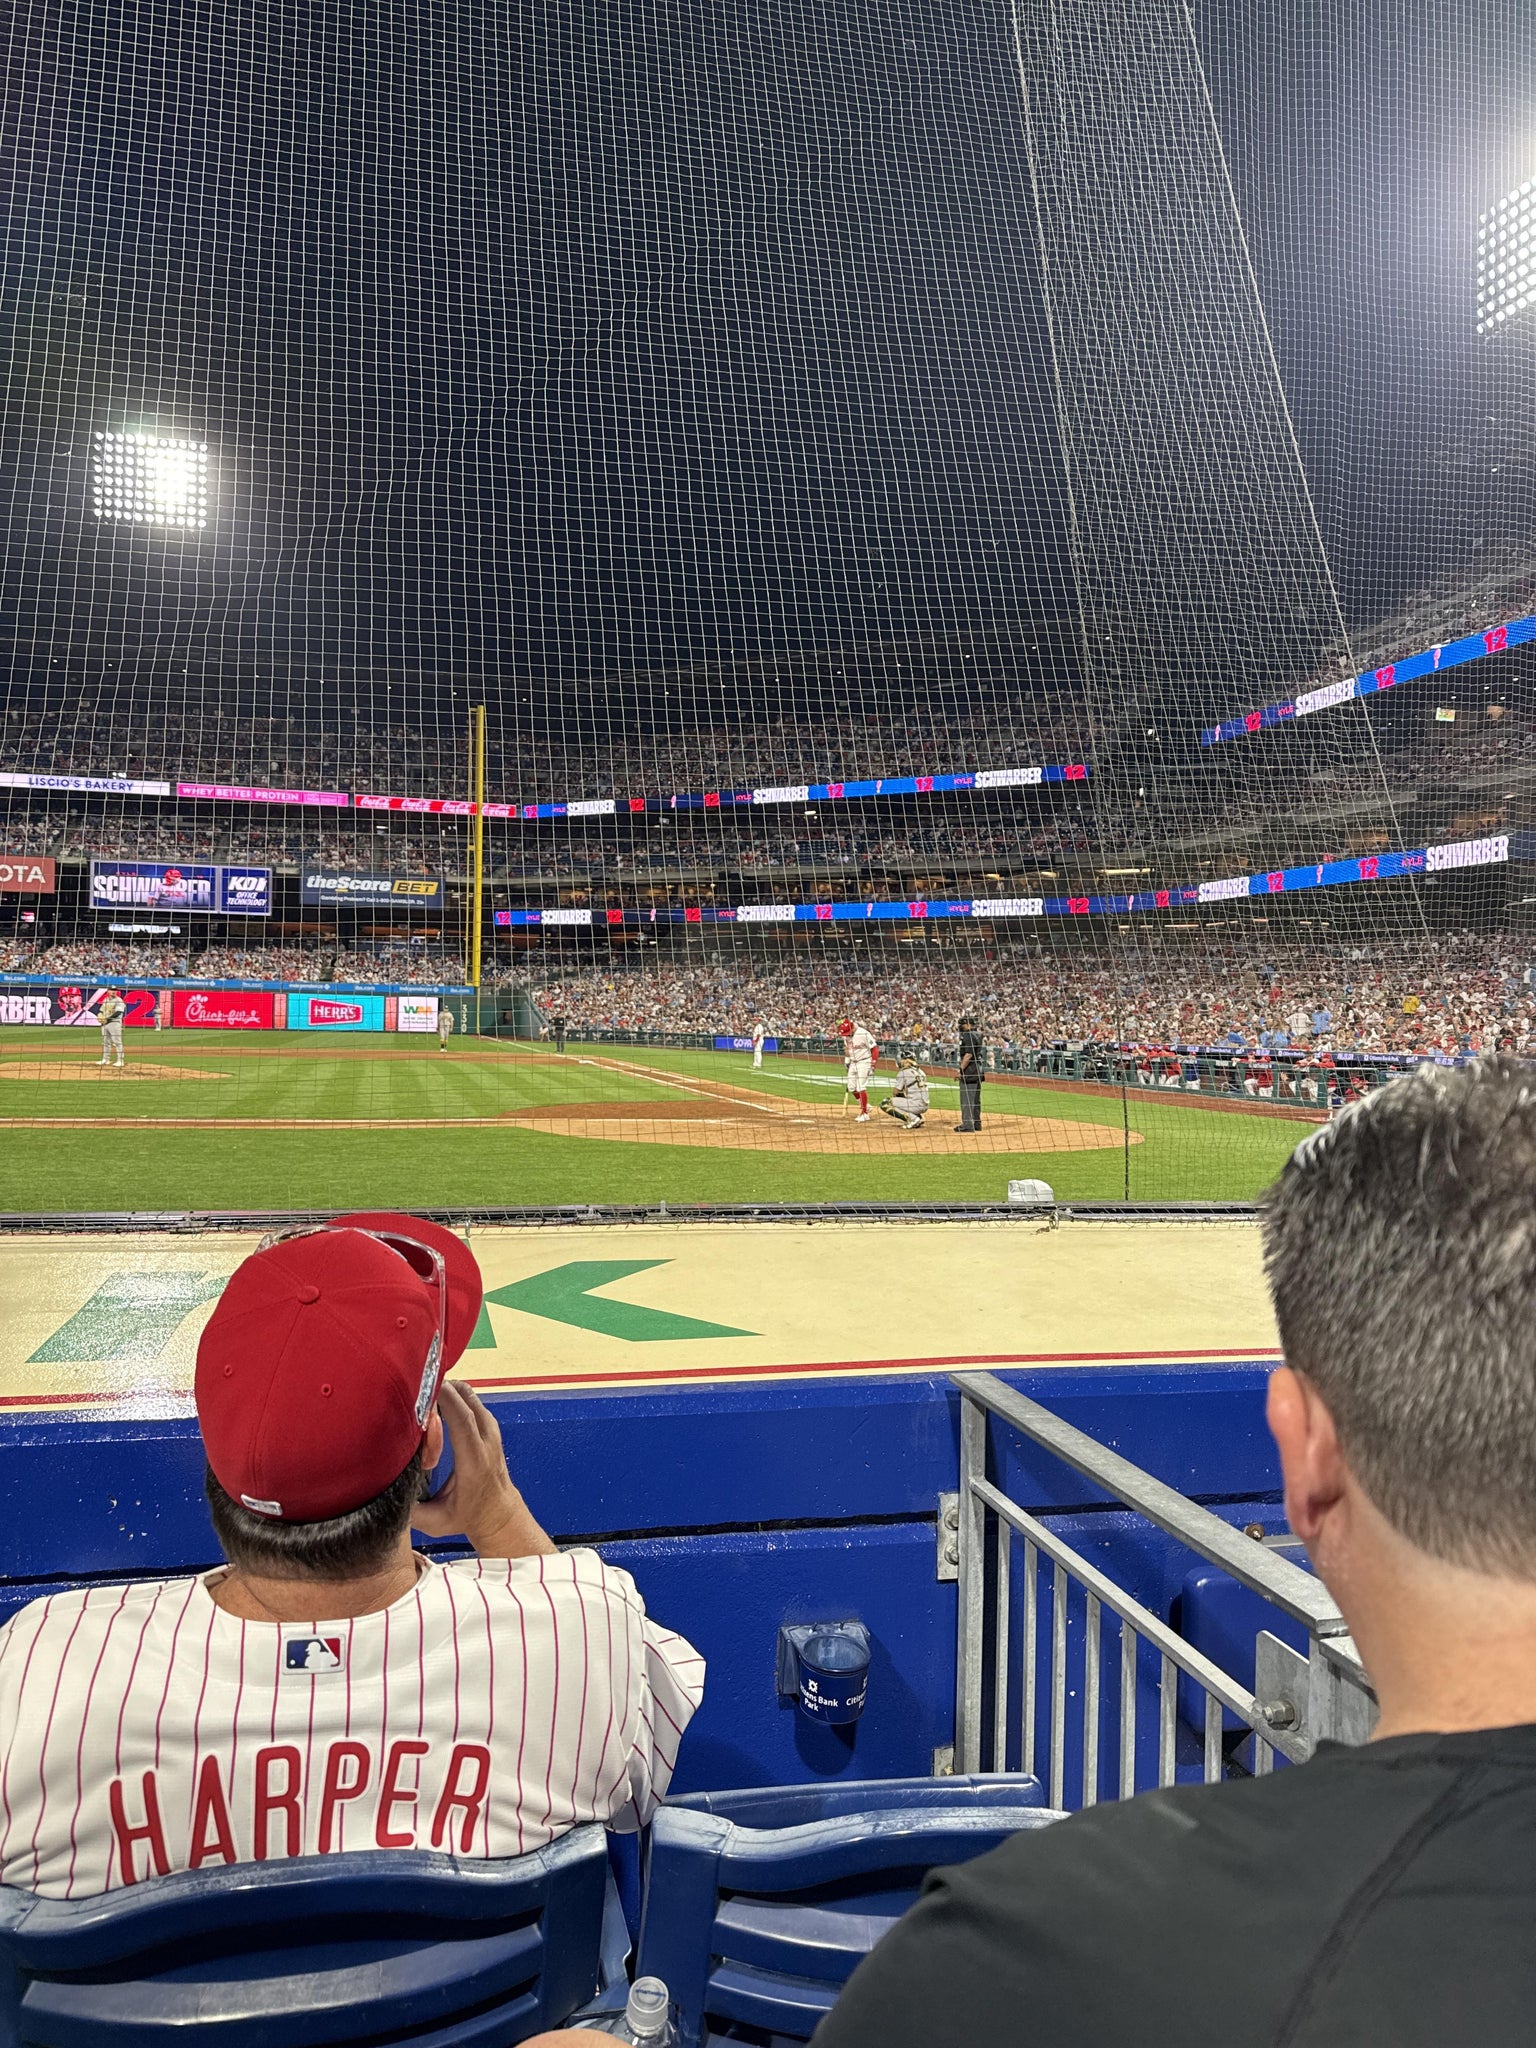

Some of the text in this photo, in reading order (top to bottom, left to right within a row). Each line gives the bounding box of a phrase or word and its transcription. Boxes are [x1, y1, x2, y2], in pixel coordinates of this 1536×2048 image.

[1483, 626, 1508, 654] 12
[1375, 664, 1395, 689] 12
[1245, 711, 1261, 732] 12
[915, 776, 933, 792] 12
[974, 767, 1042, 788] SCHWARBER
[1064, 765, 1086, 780] 12
[28, 777, 133, 791] LISCIO'S BAKERY
[827, 783, 844, 798] 12
[182, 788, 213, 796] WHEY
[215, 788, 255, 798] BETTER
[255, 790, 299, 801] PROTEIN
[704, 793, 720, 807] 12
[753, 786, 809, 804] SCHWARBER
[526, 805, 538, 818] 12
[629, 798, 644, 812] 12
[1425, 835, 1510, 872] SCHWARBER
[1358, 856, 1379, 879] 12
[227, 876, 268, 892] KDI
[306, 875, 434, 893] theScore BET
[1267, 872, 1284, 893] 12
[1067, 897, 1089, 913] 12
[1155, 890, 1170, 907] 12
[685, 907, 701, 922] 12
[736, 905, 796, 922] SCHWARBER
[815, 904, 832, 919] 12
[908, 902, 928, 918] 12
[971, 898, 1043, 918] SCHWARBER
[496, 910, 510, 924] 12
[541, 909, 592, 925] SCHWARBER
[607, 910, 622, 923] 12
[313, 1005, 357, 1020] HERR'S
[804, 1697, 819, 1712] Park
[818, 1695, 839, 1708] Bank
[108, 1738, 493, 1887] HARPER
